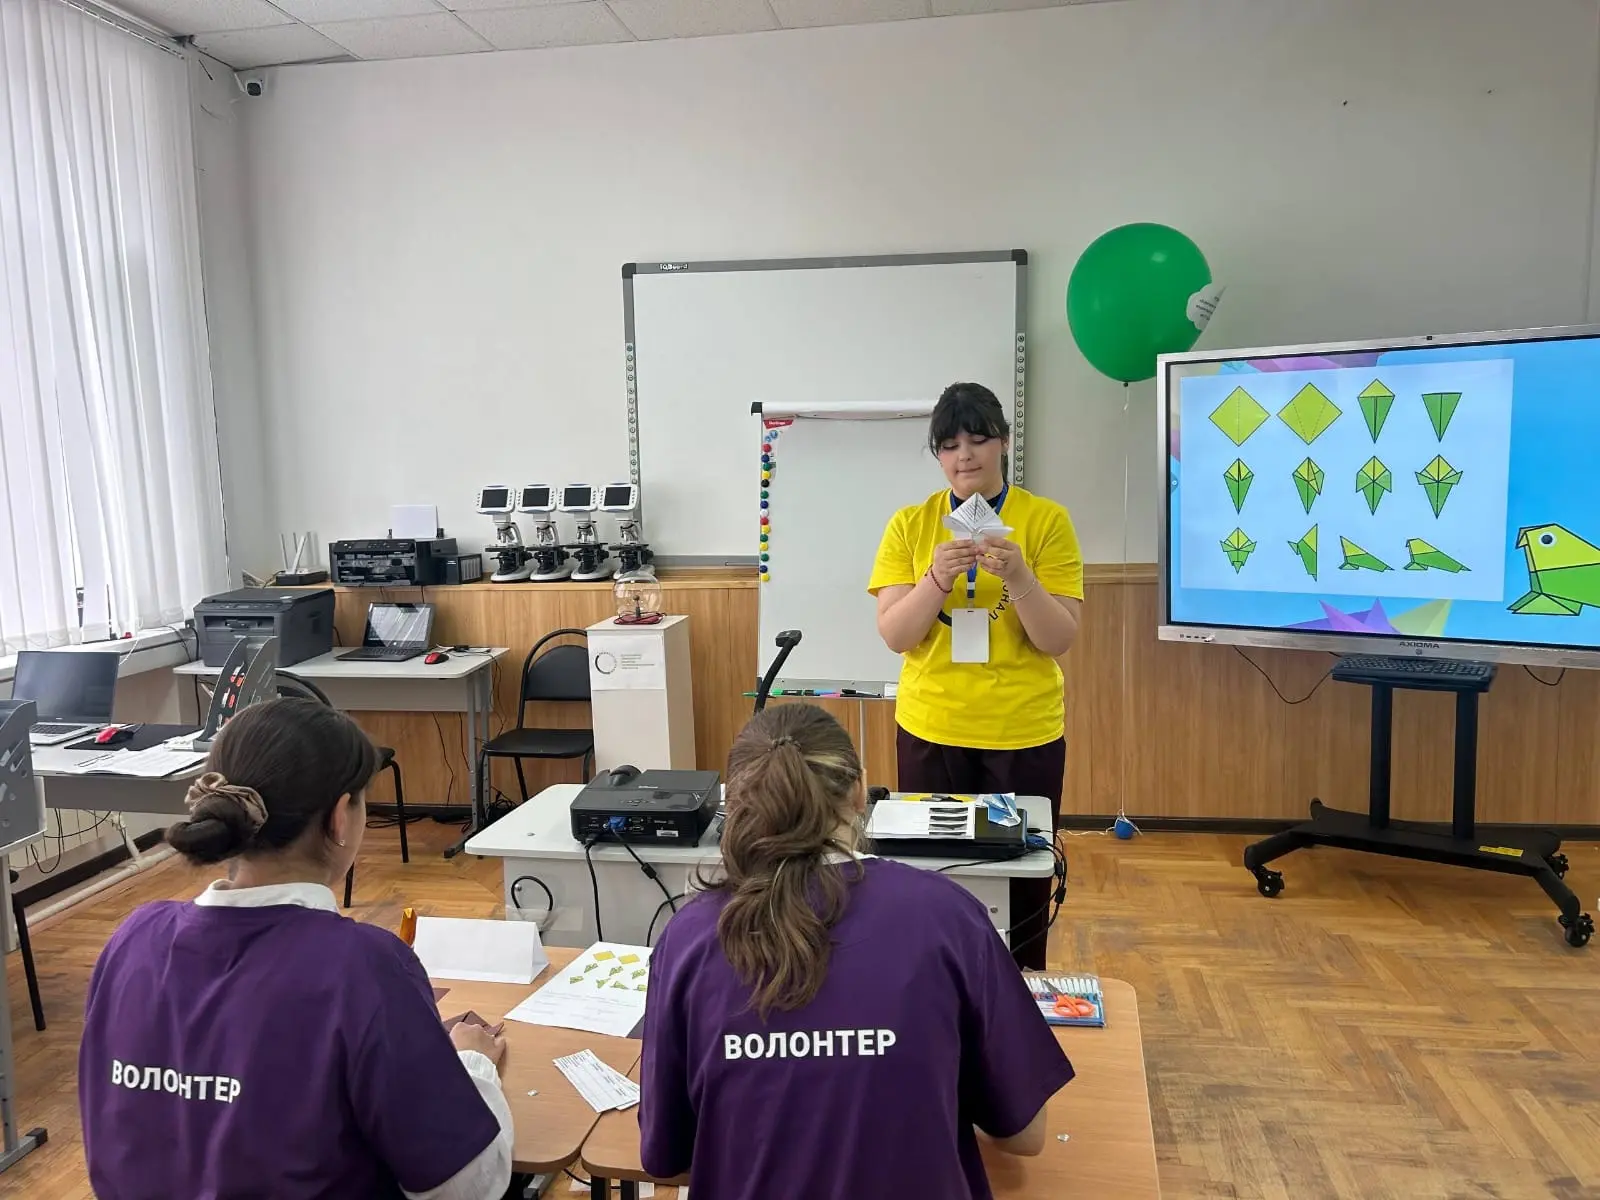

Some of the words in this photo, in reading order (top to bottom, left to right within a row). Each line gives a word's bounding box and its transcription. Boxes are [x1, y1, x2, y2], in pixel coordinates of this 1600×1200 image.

[1399, 641, 1440, 649] AXIOMA
[724, 1028, 897, 1060] ВОЛОНТЕР
[111, 1059, 242, 1104] ВОЛОНТЕР
